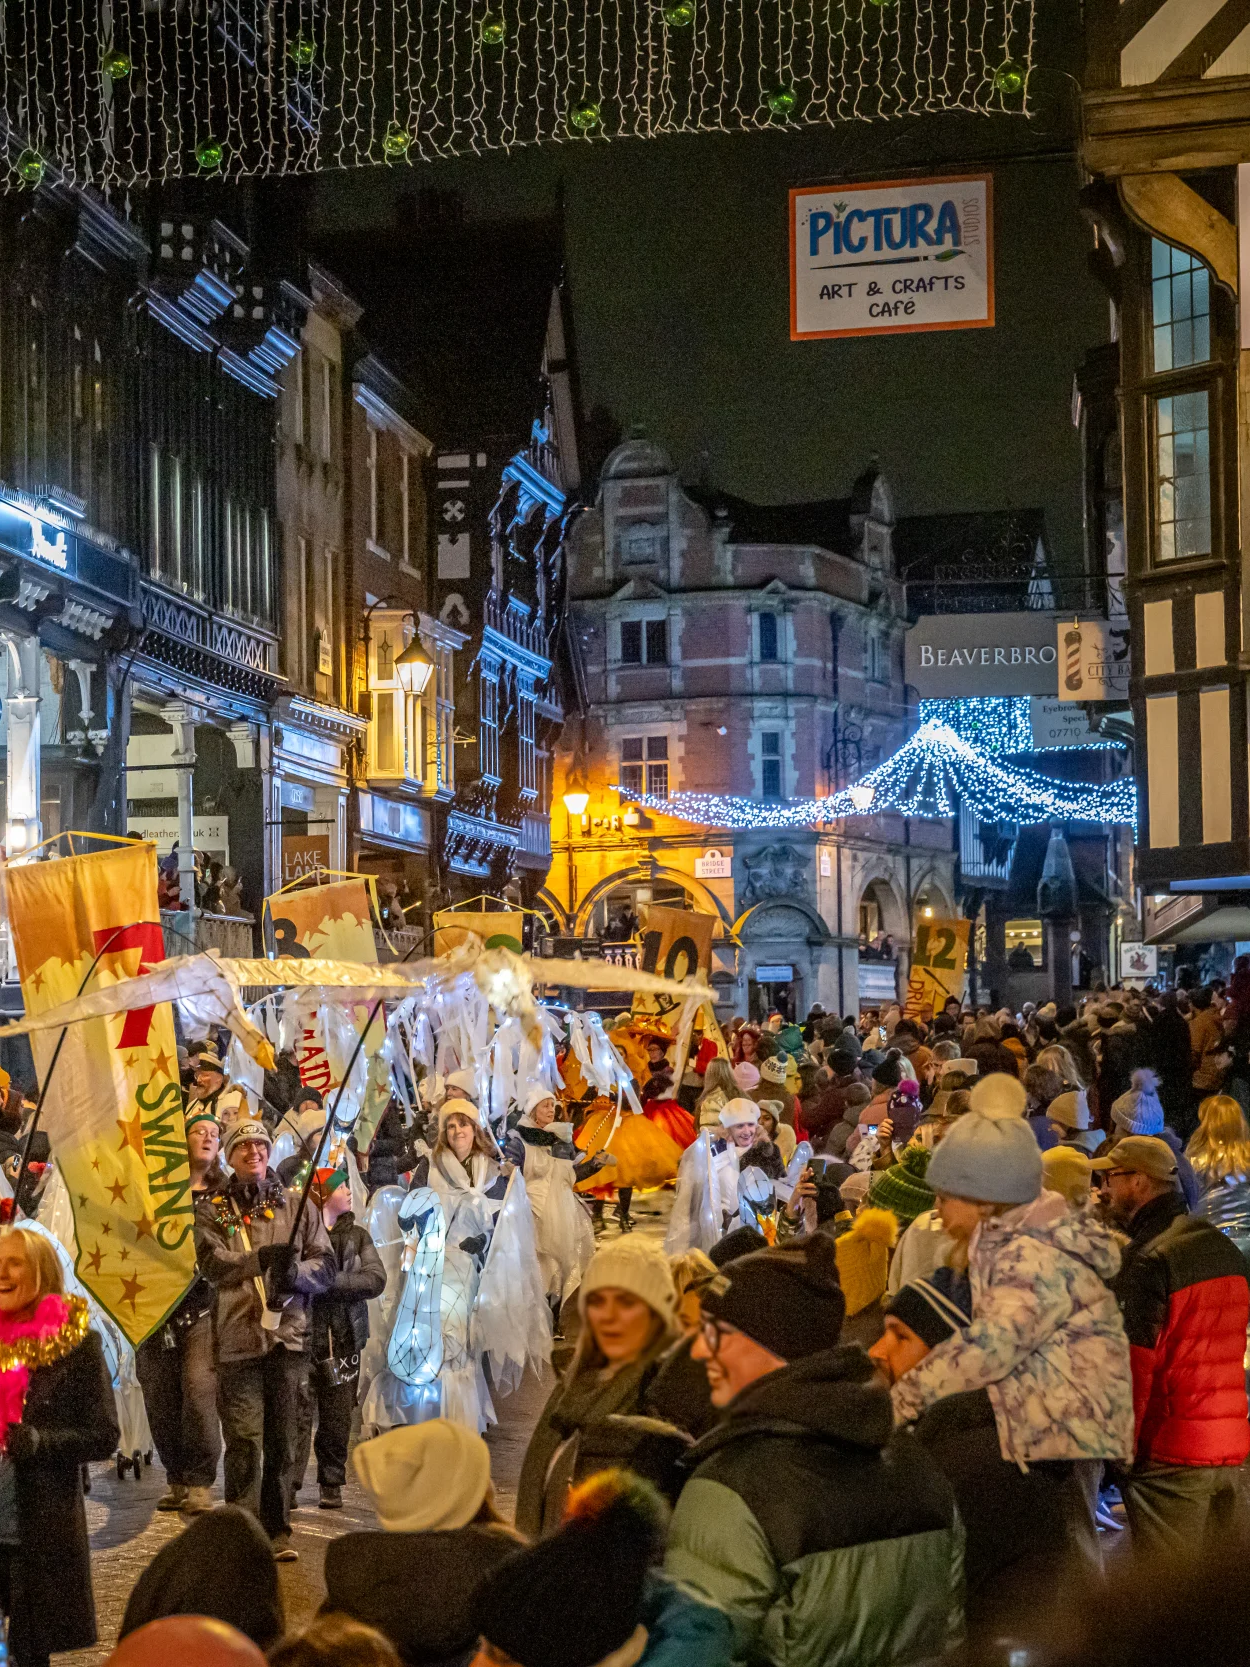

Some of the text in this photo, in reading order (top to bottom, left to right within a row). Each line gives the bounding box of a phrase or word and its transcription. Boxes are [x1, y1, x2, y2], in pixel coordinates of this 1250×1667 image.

[963, 197, 979, 246] STUDIOS
[819, 282, 858, 300] ART
[866, 281, 883, 297] &
[919, 644, 1057, 667] BEAVERBRO
[1087, 664, 1113, 677] CITY
[1049, 727, 1081, 739] 07710
[284, 850, 322, 866] LAKE
[285, 865, 327, 880] LAND
[701, 867, 725, 875] STREET
[641, 930, 699, 982] 10
[912, 924, 957, 970] 12
[92, 921, 166, 1050] 7
[135, 1081, 196, 1251] SWANS
